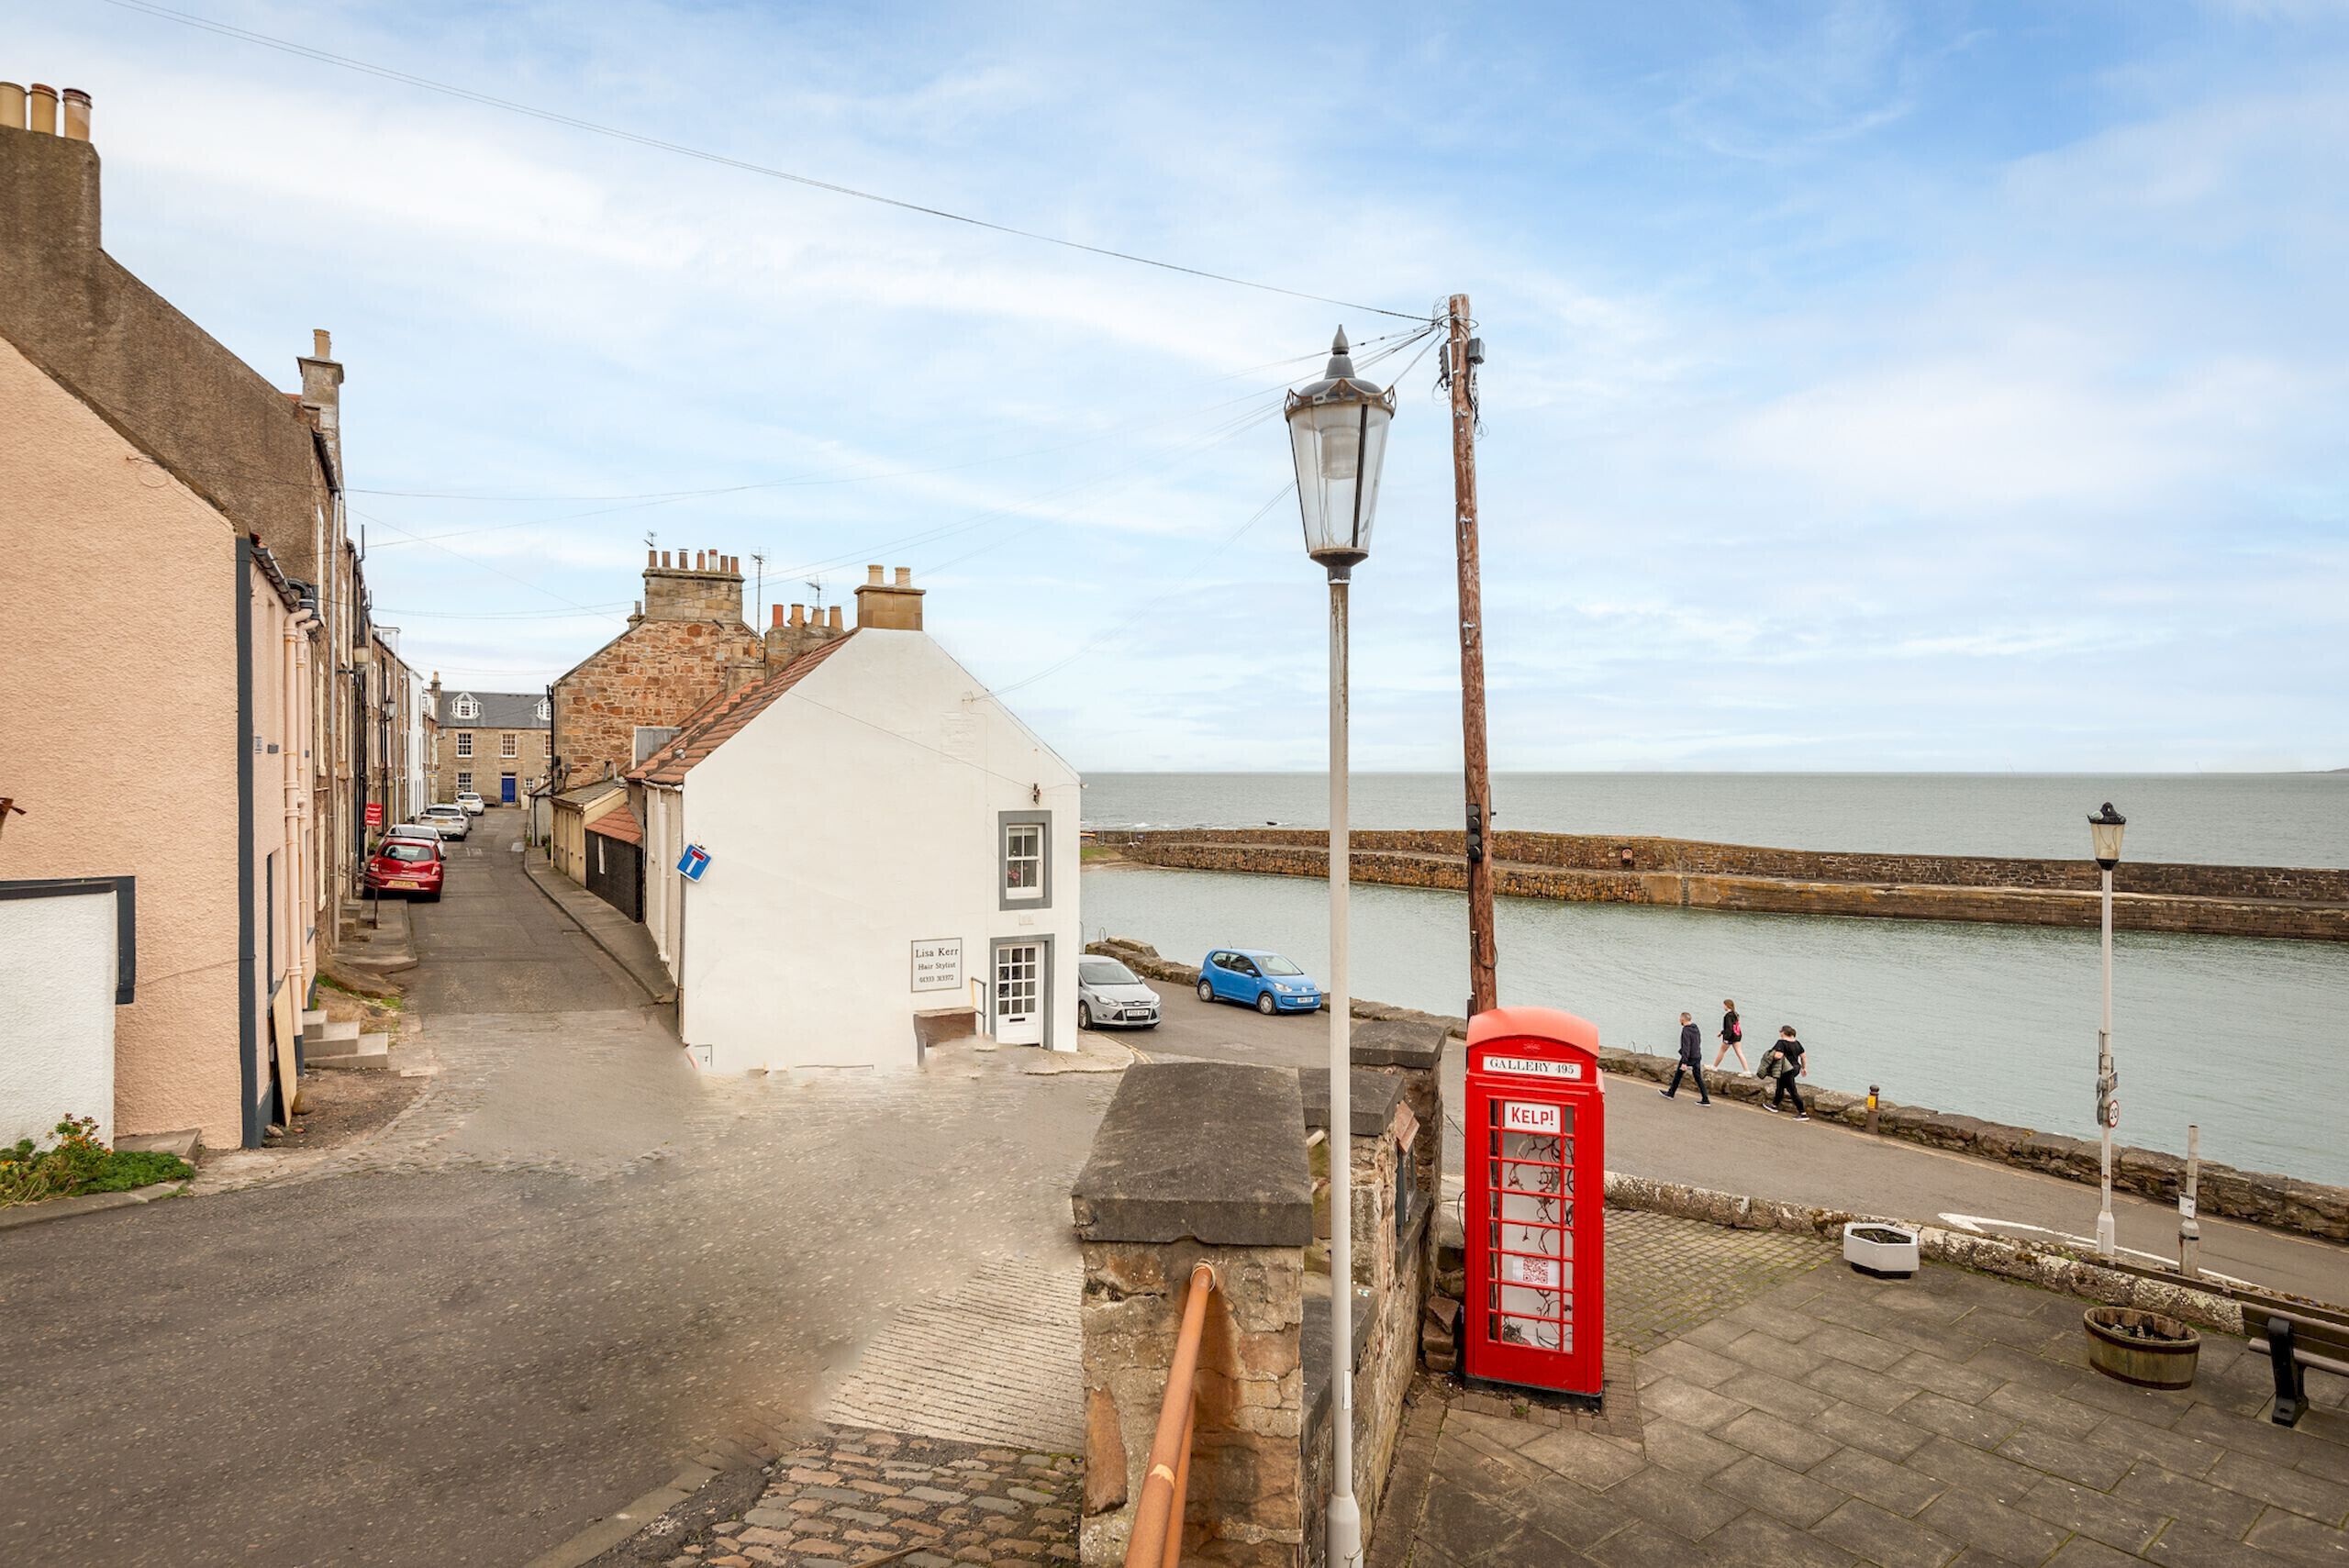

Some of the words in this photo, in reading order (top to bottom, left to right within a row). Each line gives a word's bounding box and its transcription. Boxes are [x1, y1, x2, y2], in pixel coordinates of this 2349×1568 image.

[916, 949, 934, 958] Lisa
[938, 947, 959, 956] Kerr
[1489, 1057, 1551, 1073] GALLERY
[1554, 1063, 1575, 1074] 495
[1511, 1106, 1554, 1126] KELP!
